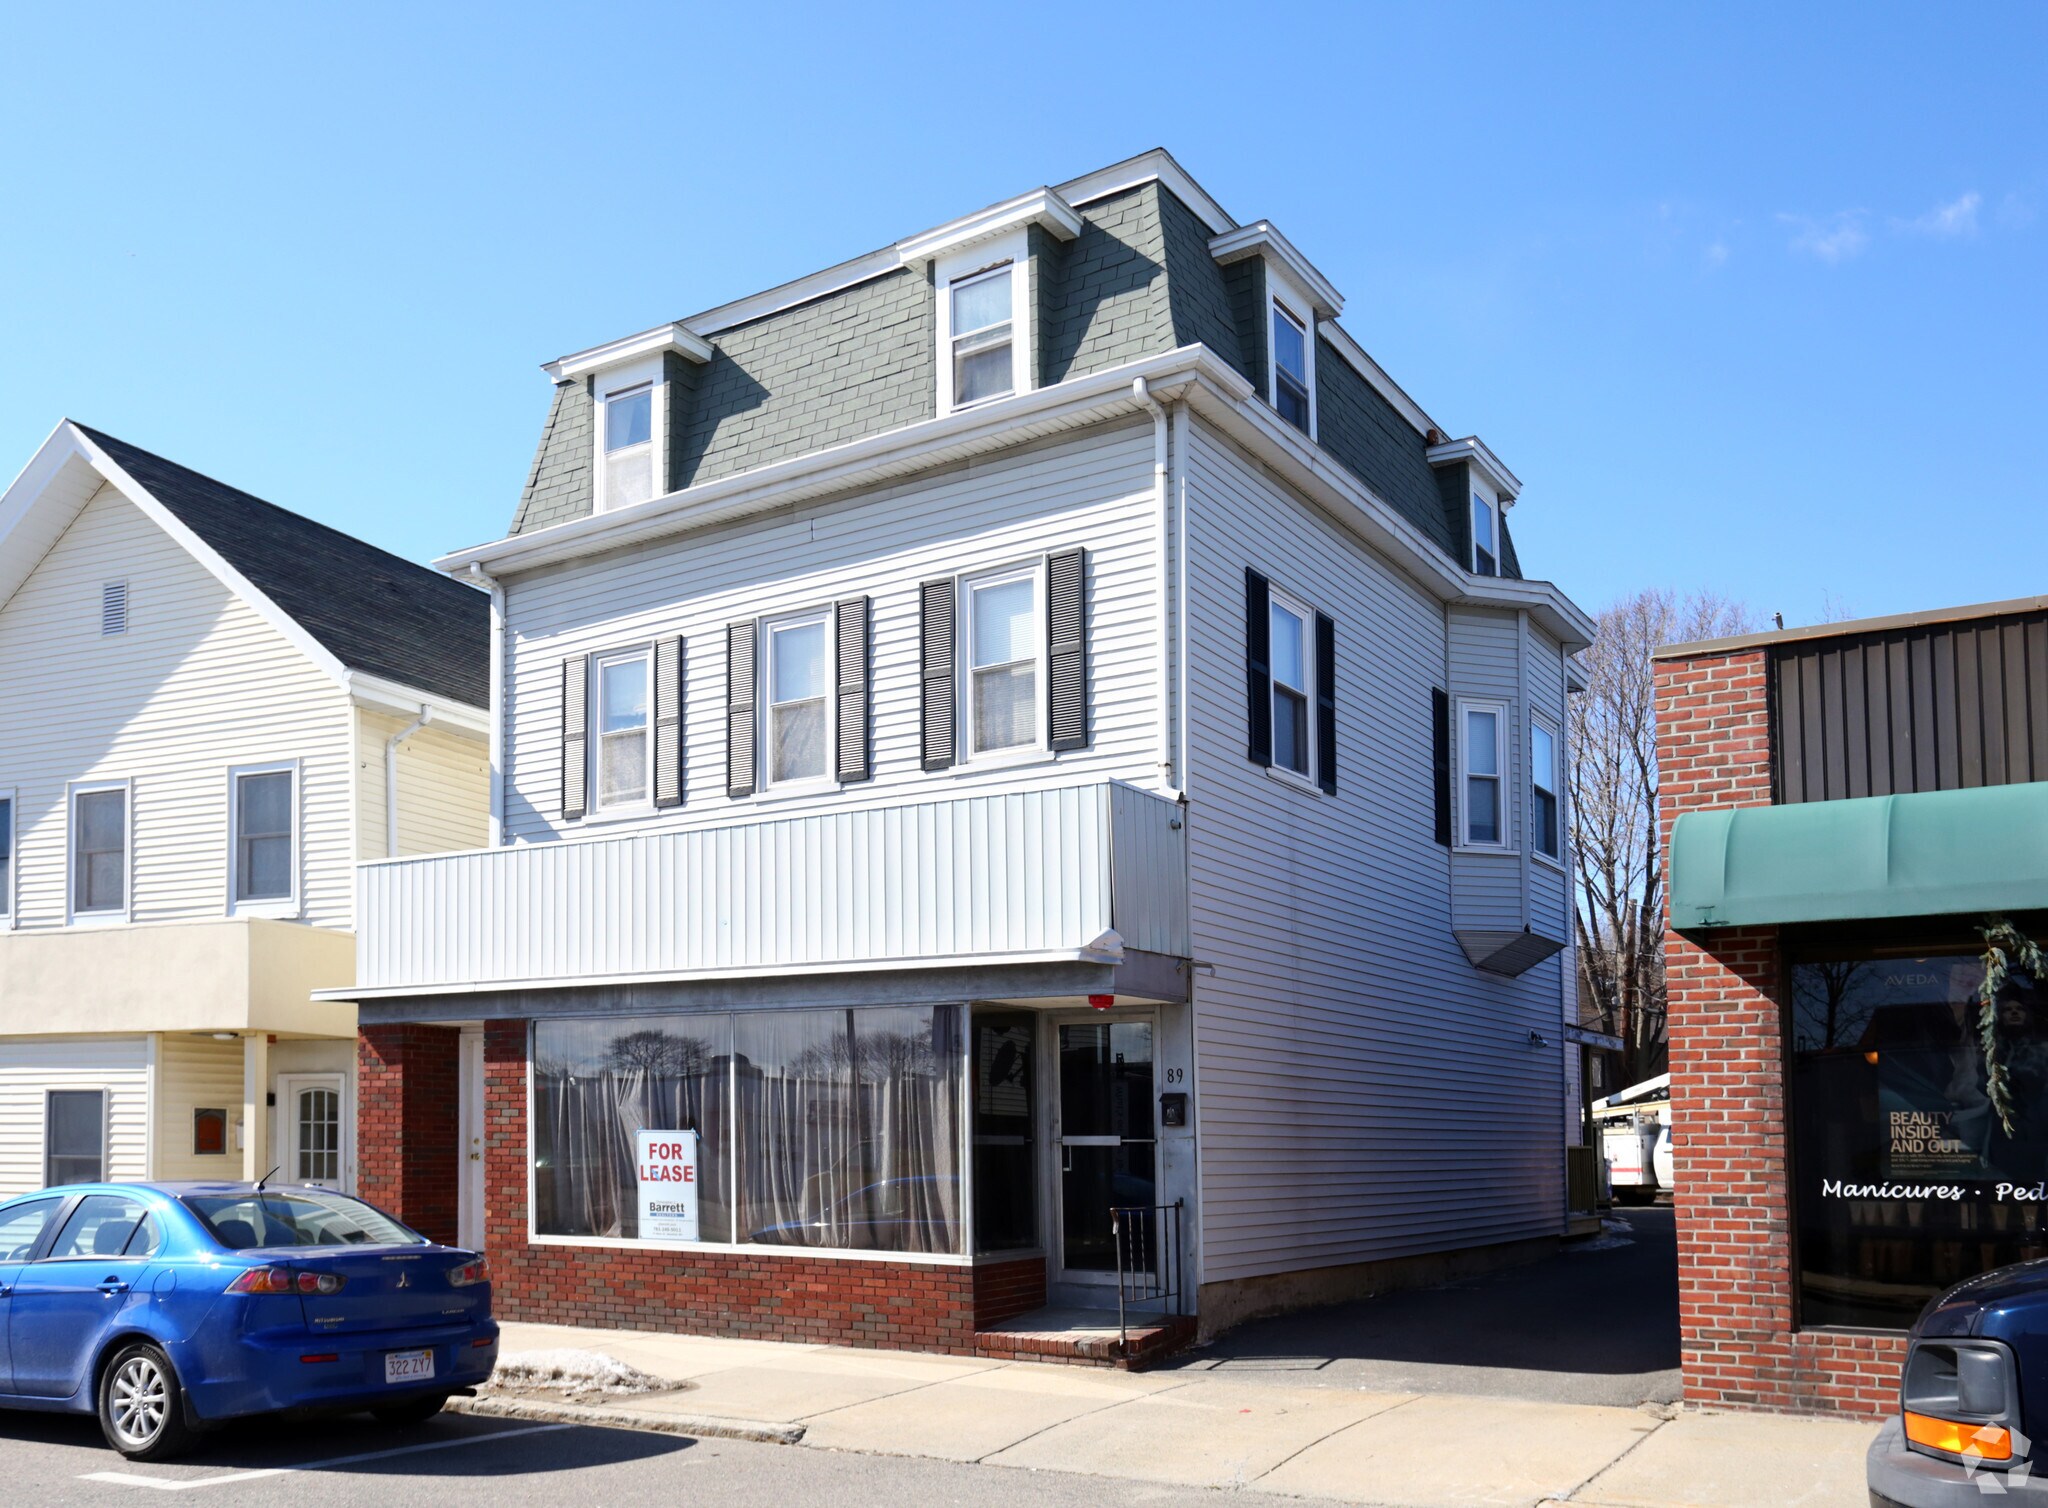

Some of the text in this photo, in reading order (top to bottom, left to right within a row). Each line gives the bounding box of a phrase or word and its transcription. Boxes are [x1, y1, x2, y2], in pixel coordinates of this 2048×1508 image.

[1884, 974, 1939, 986] AVEDA
[1167, 1068, 1183, 1084] 89
[1890, 1111, 1953, 1125] BEAUTY
[1890, 1125, 1941, 1139] INSIDE
[649, 1143, 683, 1160] FOR
[1890, 1139, 1961, 1153] AND OUT
[640, 1165, 694, 1182] LEASE
[1822, 1178, 1966, 1201] Manicures
[649, 1202, 685, 1213] Barrett
[389, 1357, 432, 1376] 322 ZY7
